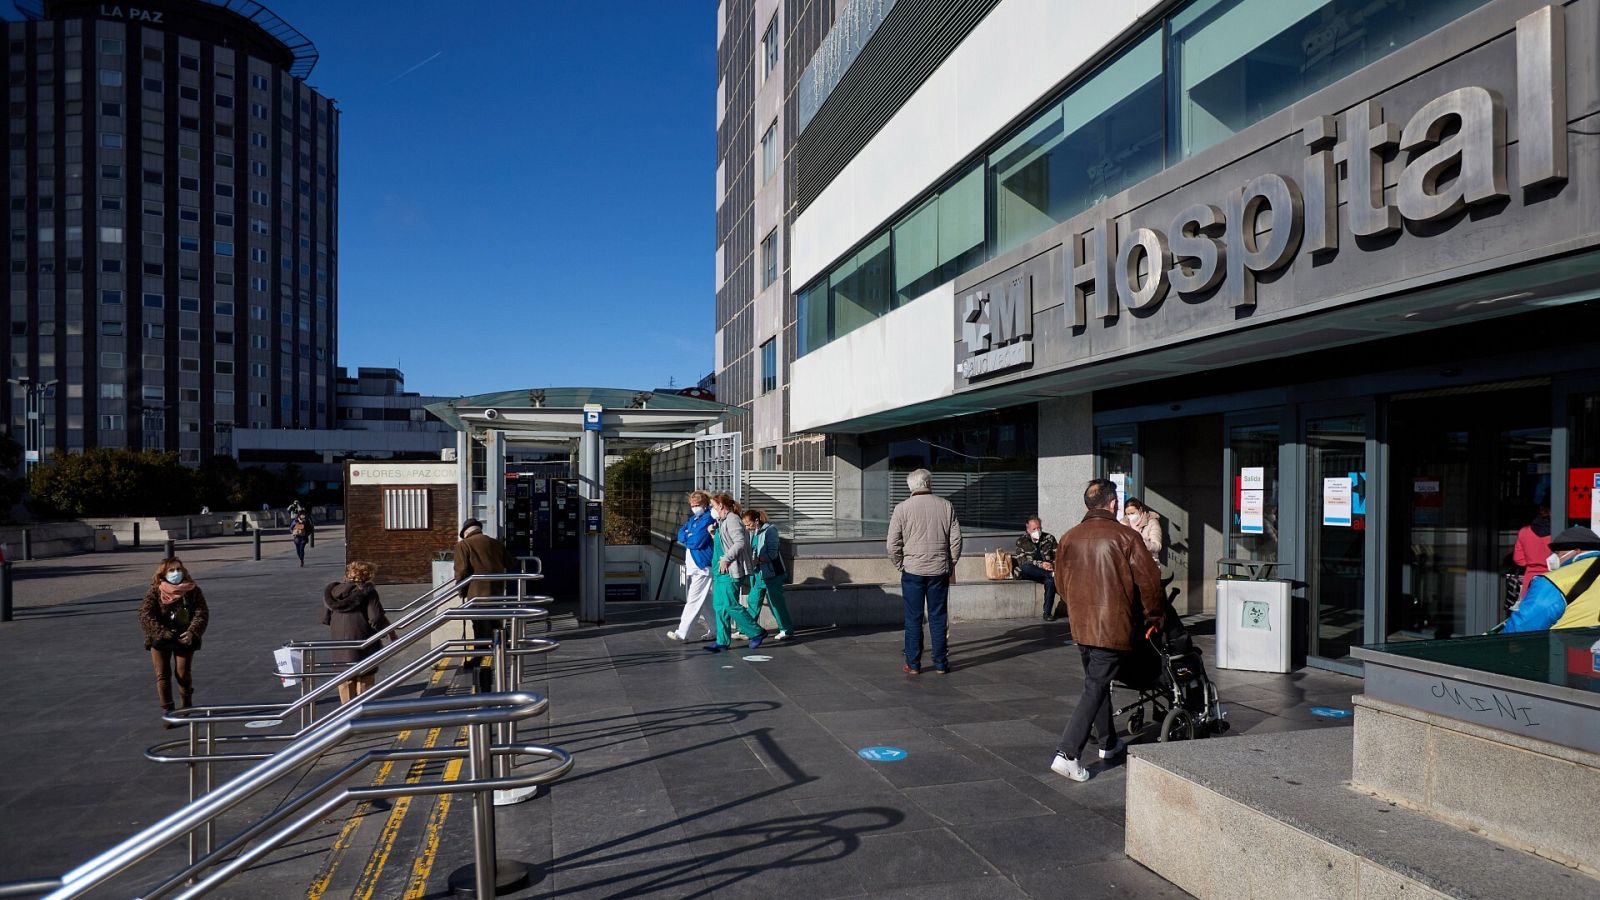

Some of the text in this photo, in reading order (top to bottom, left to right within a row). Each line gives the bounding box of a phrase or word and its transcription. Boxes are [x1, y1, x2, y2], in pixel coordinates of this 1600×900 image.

[100, 4, 164, 24] LA PAZ
[1063, 4, 1568, 329] Hospital
